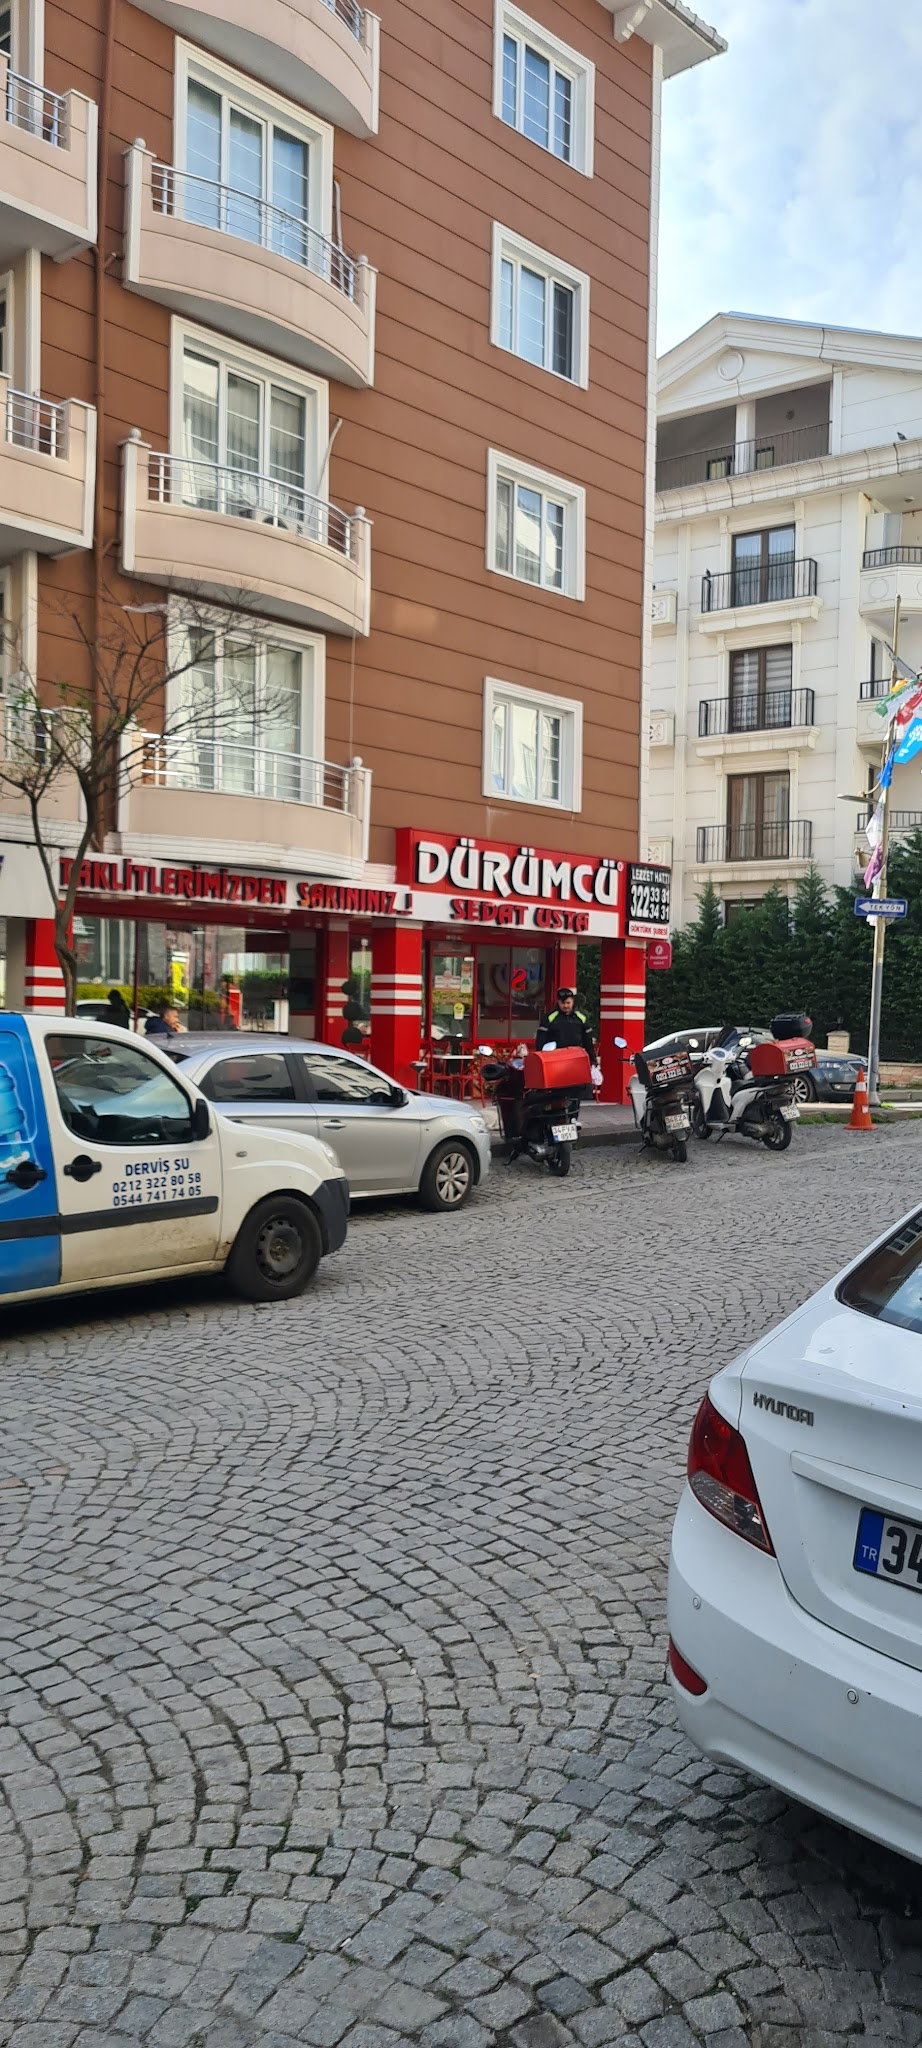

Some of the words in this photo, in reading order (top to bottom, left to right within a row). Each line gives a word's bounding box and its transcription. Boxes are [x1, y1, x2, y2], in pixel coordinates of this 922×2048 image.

[417, 837, 619, 906] DÜRÜMCÜ
[631, 867, 654, 882] LEZZET
[630, 885, 650, 918] 322
[650, 886, 660, 903] 33
[649, 903, 660, 919] 34
[886, 903, 901, 911] YÖN
[450, 898, 529, 926] SEDAT
[534, 906, 590, 933] USTA
[125, 1157, 170, 1176] DERVİŞ
[174, 1157, 190, 1171] SU
[113, 1180, 142, 1193] 0212
[146, 1177, 167, 1189] 322
[170, 1174, 184, 1186] 80
[188, 1172, 201, 1184] 58
[113, 1193, 142, 1206] 0544
[146, 1189, 166, 1202] 741
[171, 1187, 185, 1199] 74
[188, 1185, 201, 1197] 05
[753, 1392, 815, 1427] HYUNDAI
[862, 1544, 878, 1562] TR
